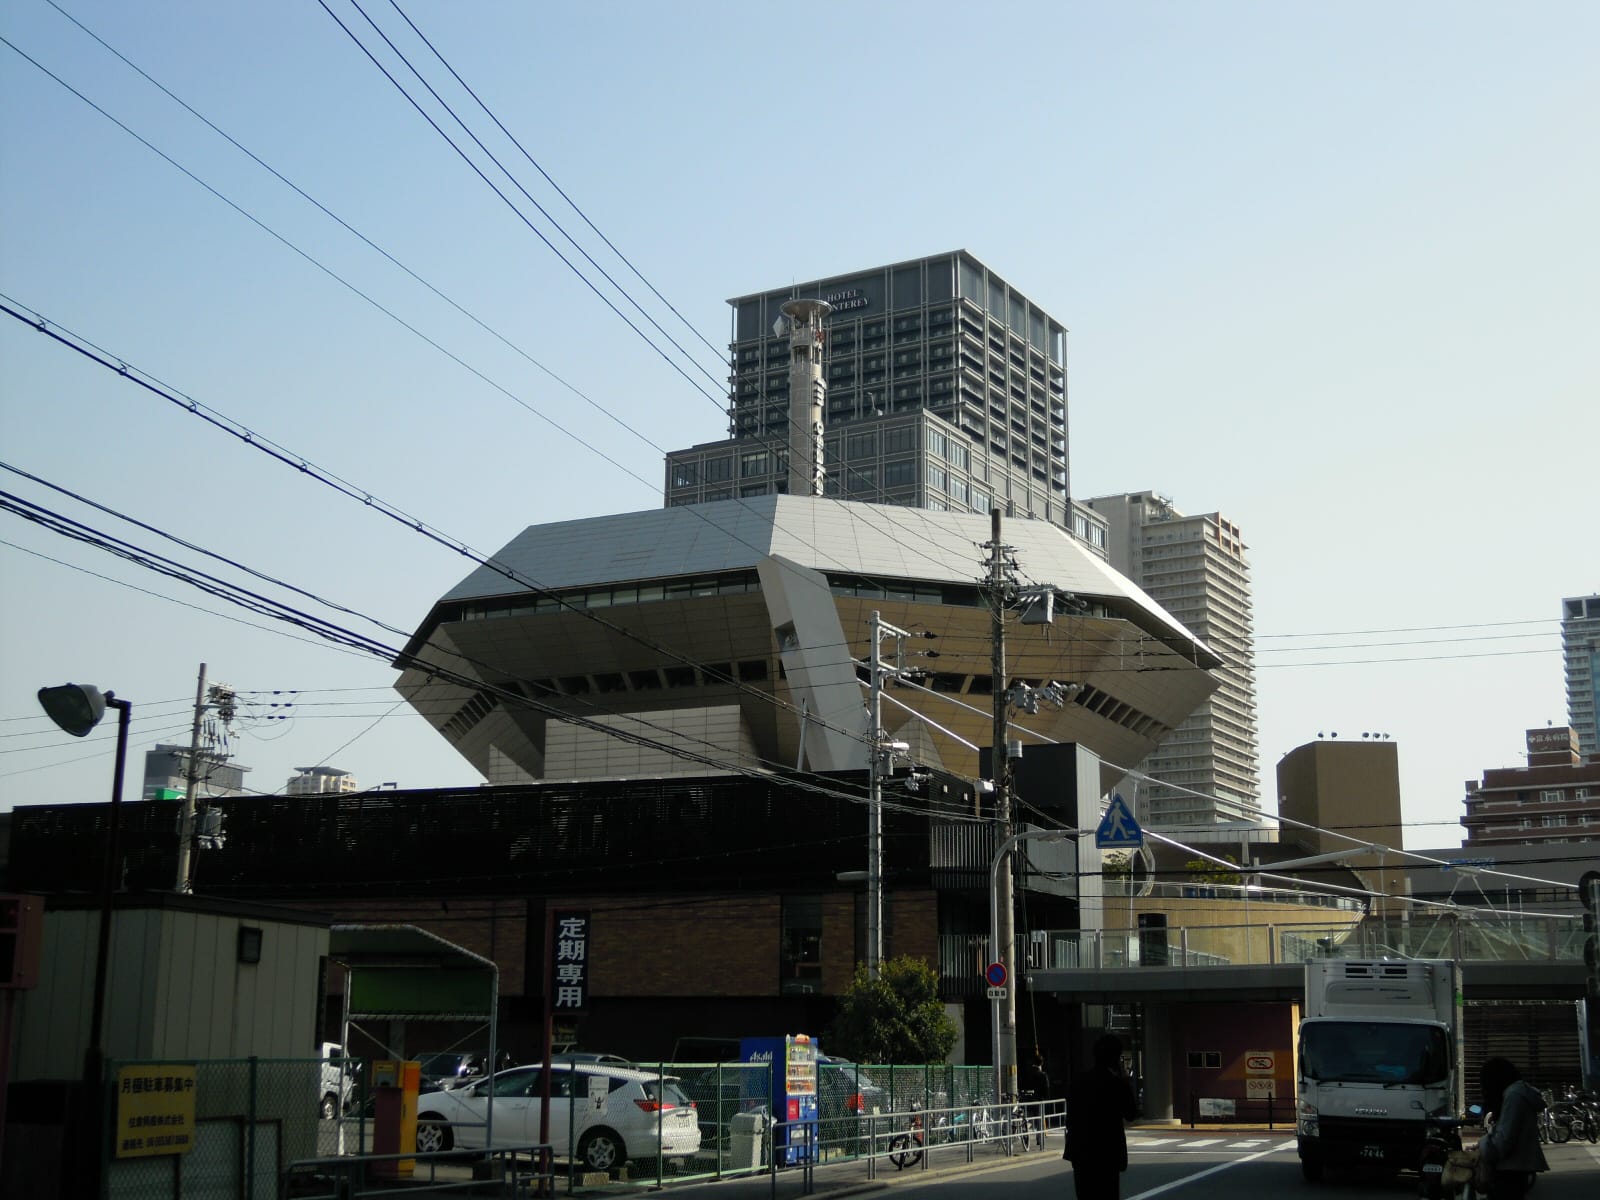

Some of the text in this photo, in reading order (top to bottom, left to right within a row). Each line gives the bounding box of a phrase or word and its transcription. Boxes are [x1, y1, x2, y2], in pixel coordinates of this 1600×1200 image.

[827, 289, 859, 302] HOTEL
[831, 297, 870, 311] NTEREY
[556, 917, 586, 1008] 定期専用
[749, 1050, 773, 1063] Asahi
[1355, 1108, 1388, 1116] ISUZU
